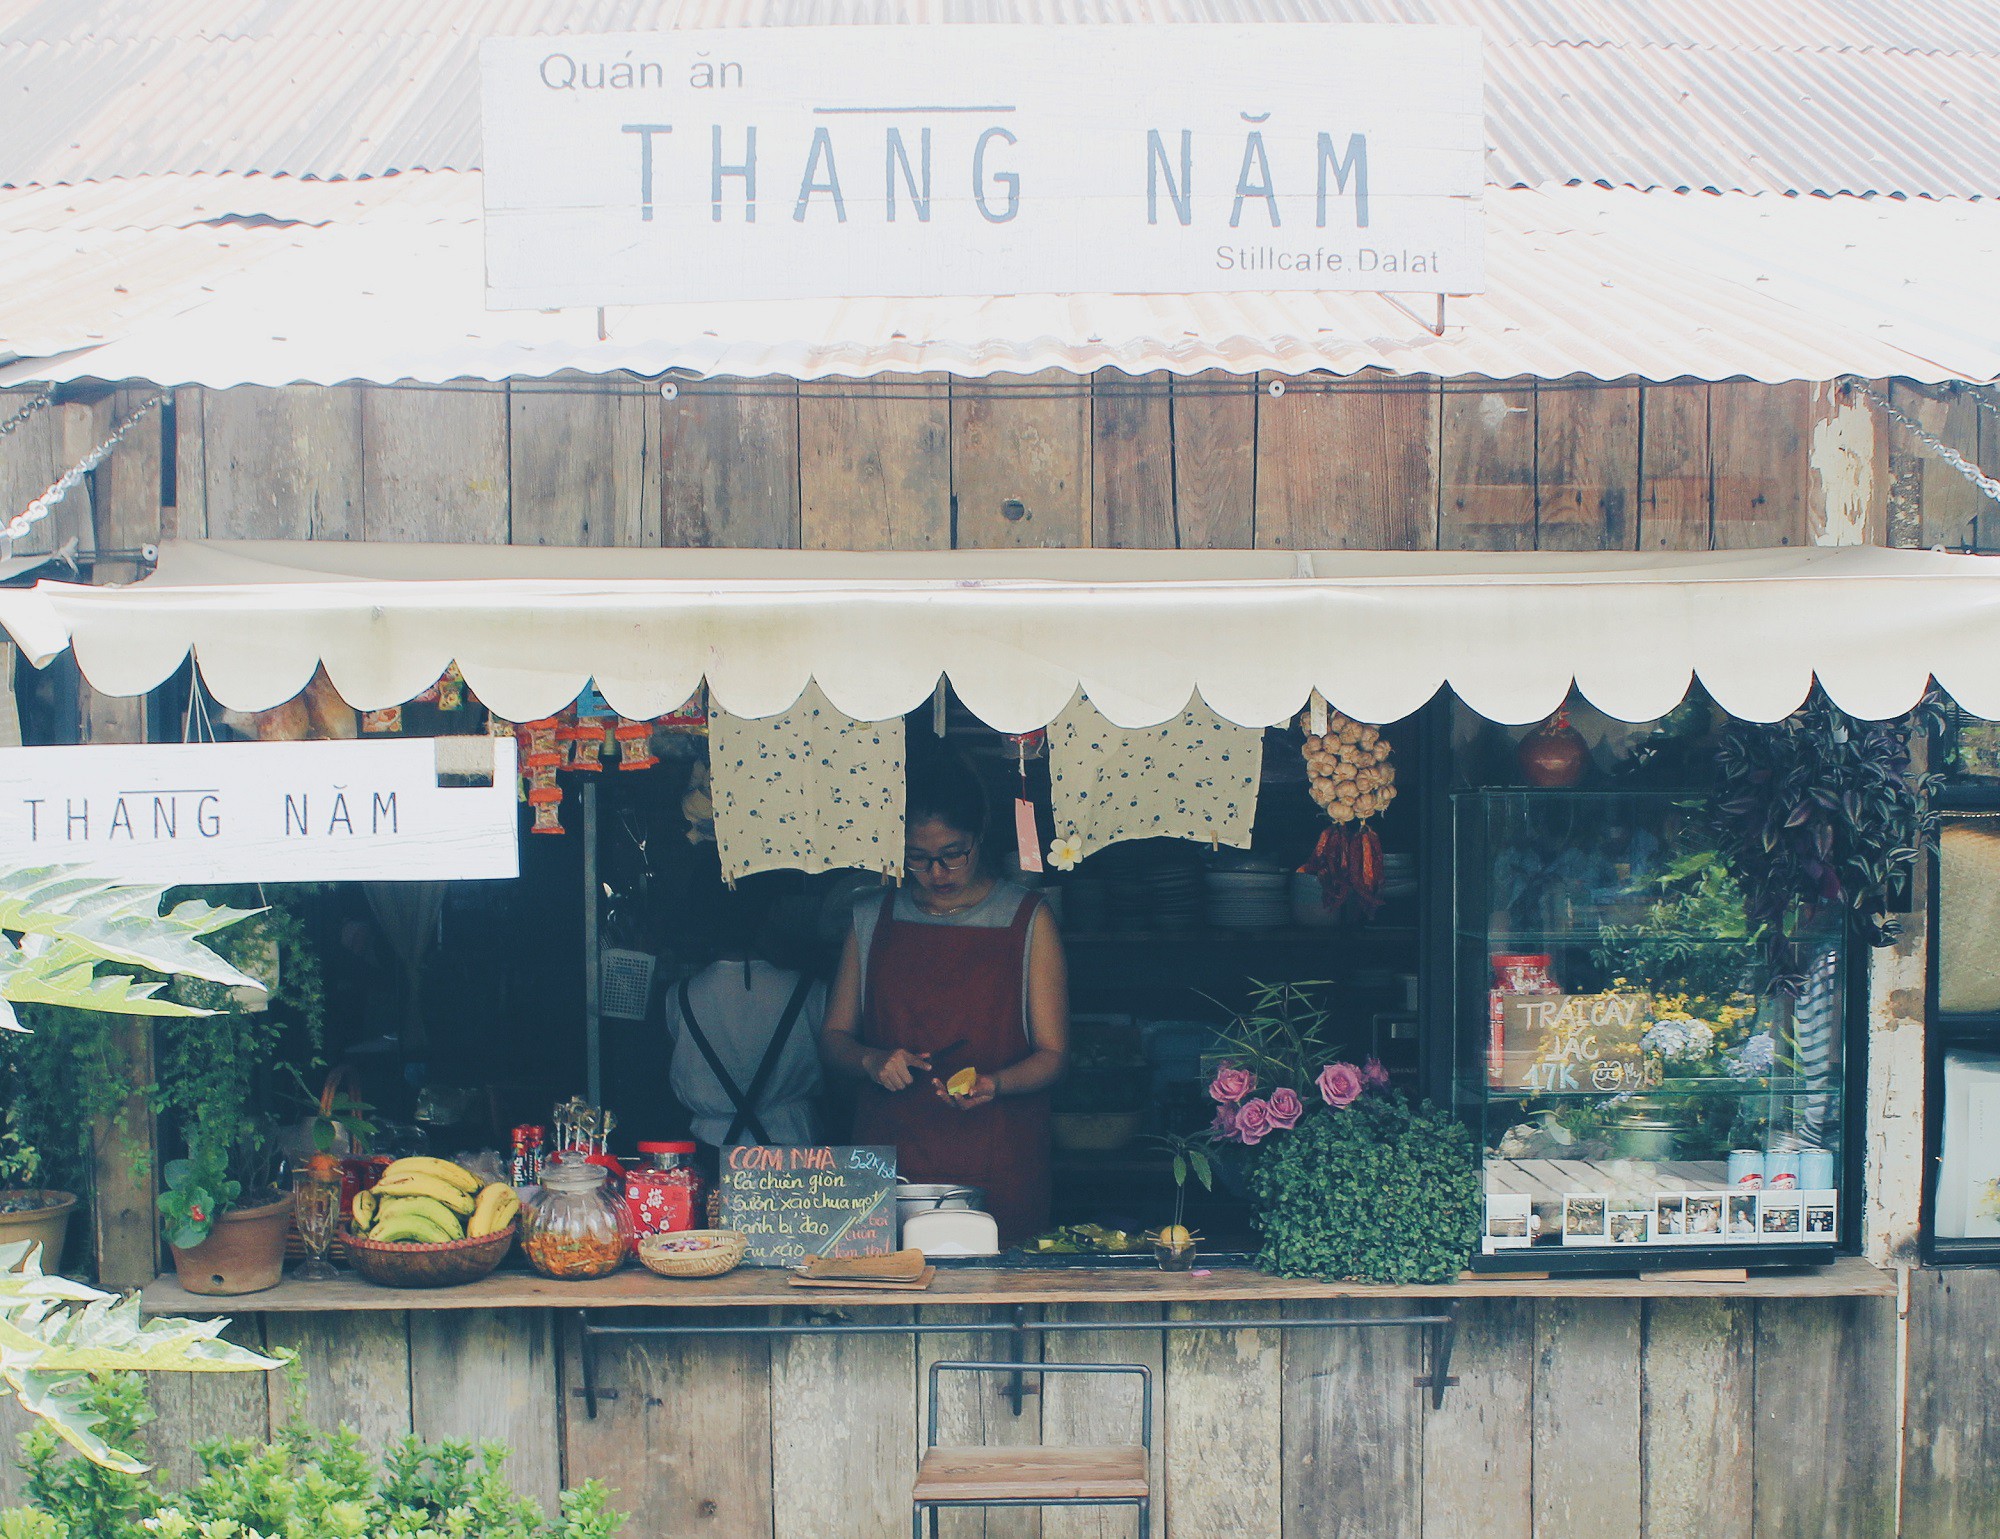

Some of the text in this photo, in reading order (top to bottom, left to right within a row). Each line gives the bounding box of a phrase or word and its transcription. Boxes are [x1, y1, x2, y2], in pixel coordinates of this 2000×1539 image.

[539, 52, 744, 91] Quán ăn
[1147, 111, 1369, 229] NĂM
[285, 784, 398, 836] NĂM
[791, 1146, 837, 1170] NHÀ
